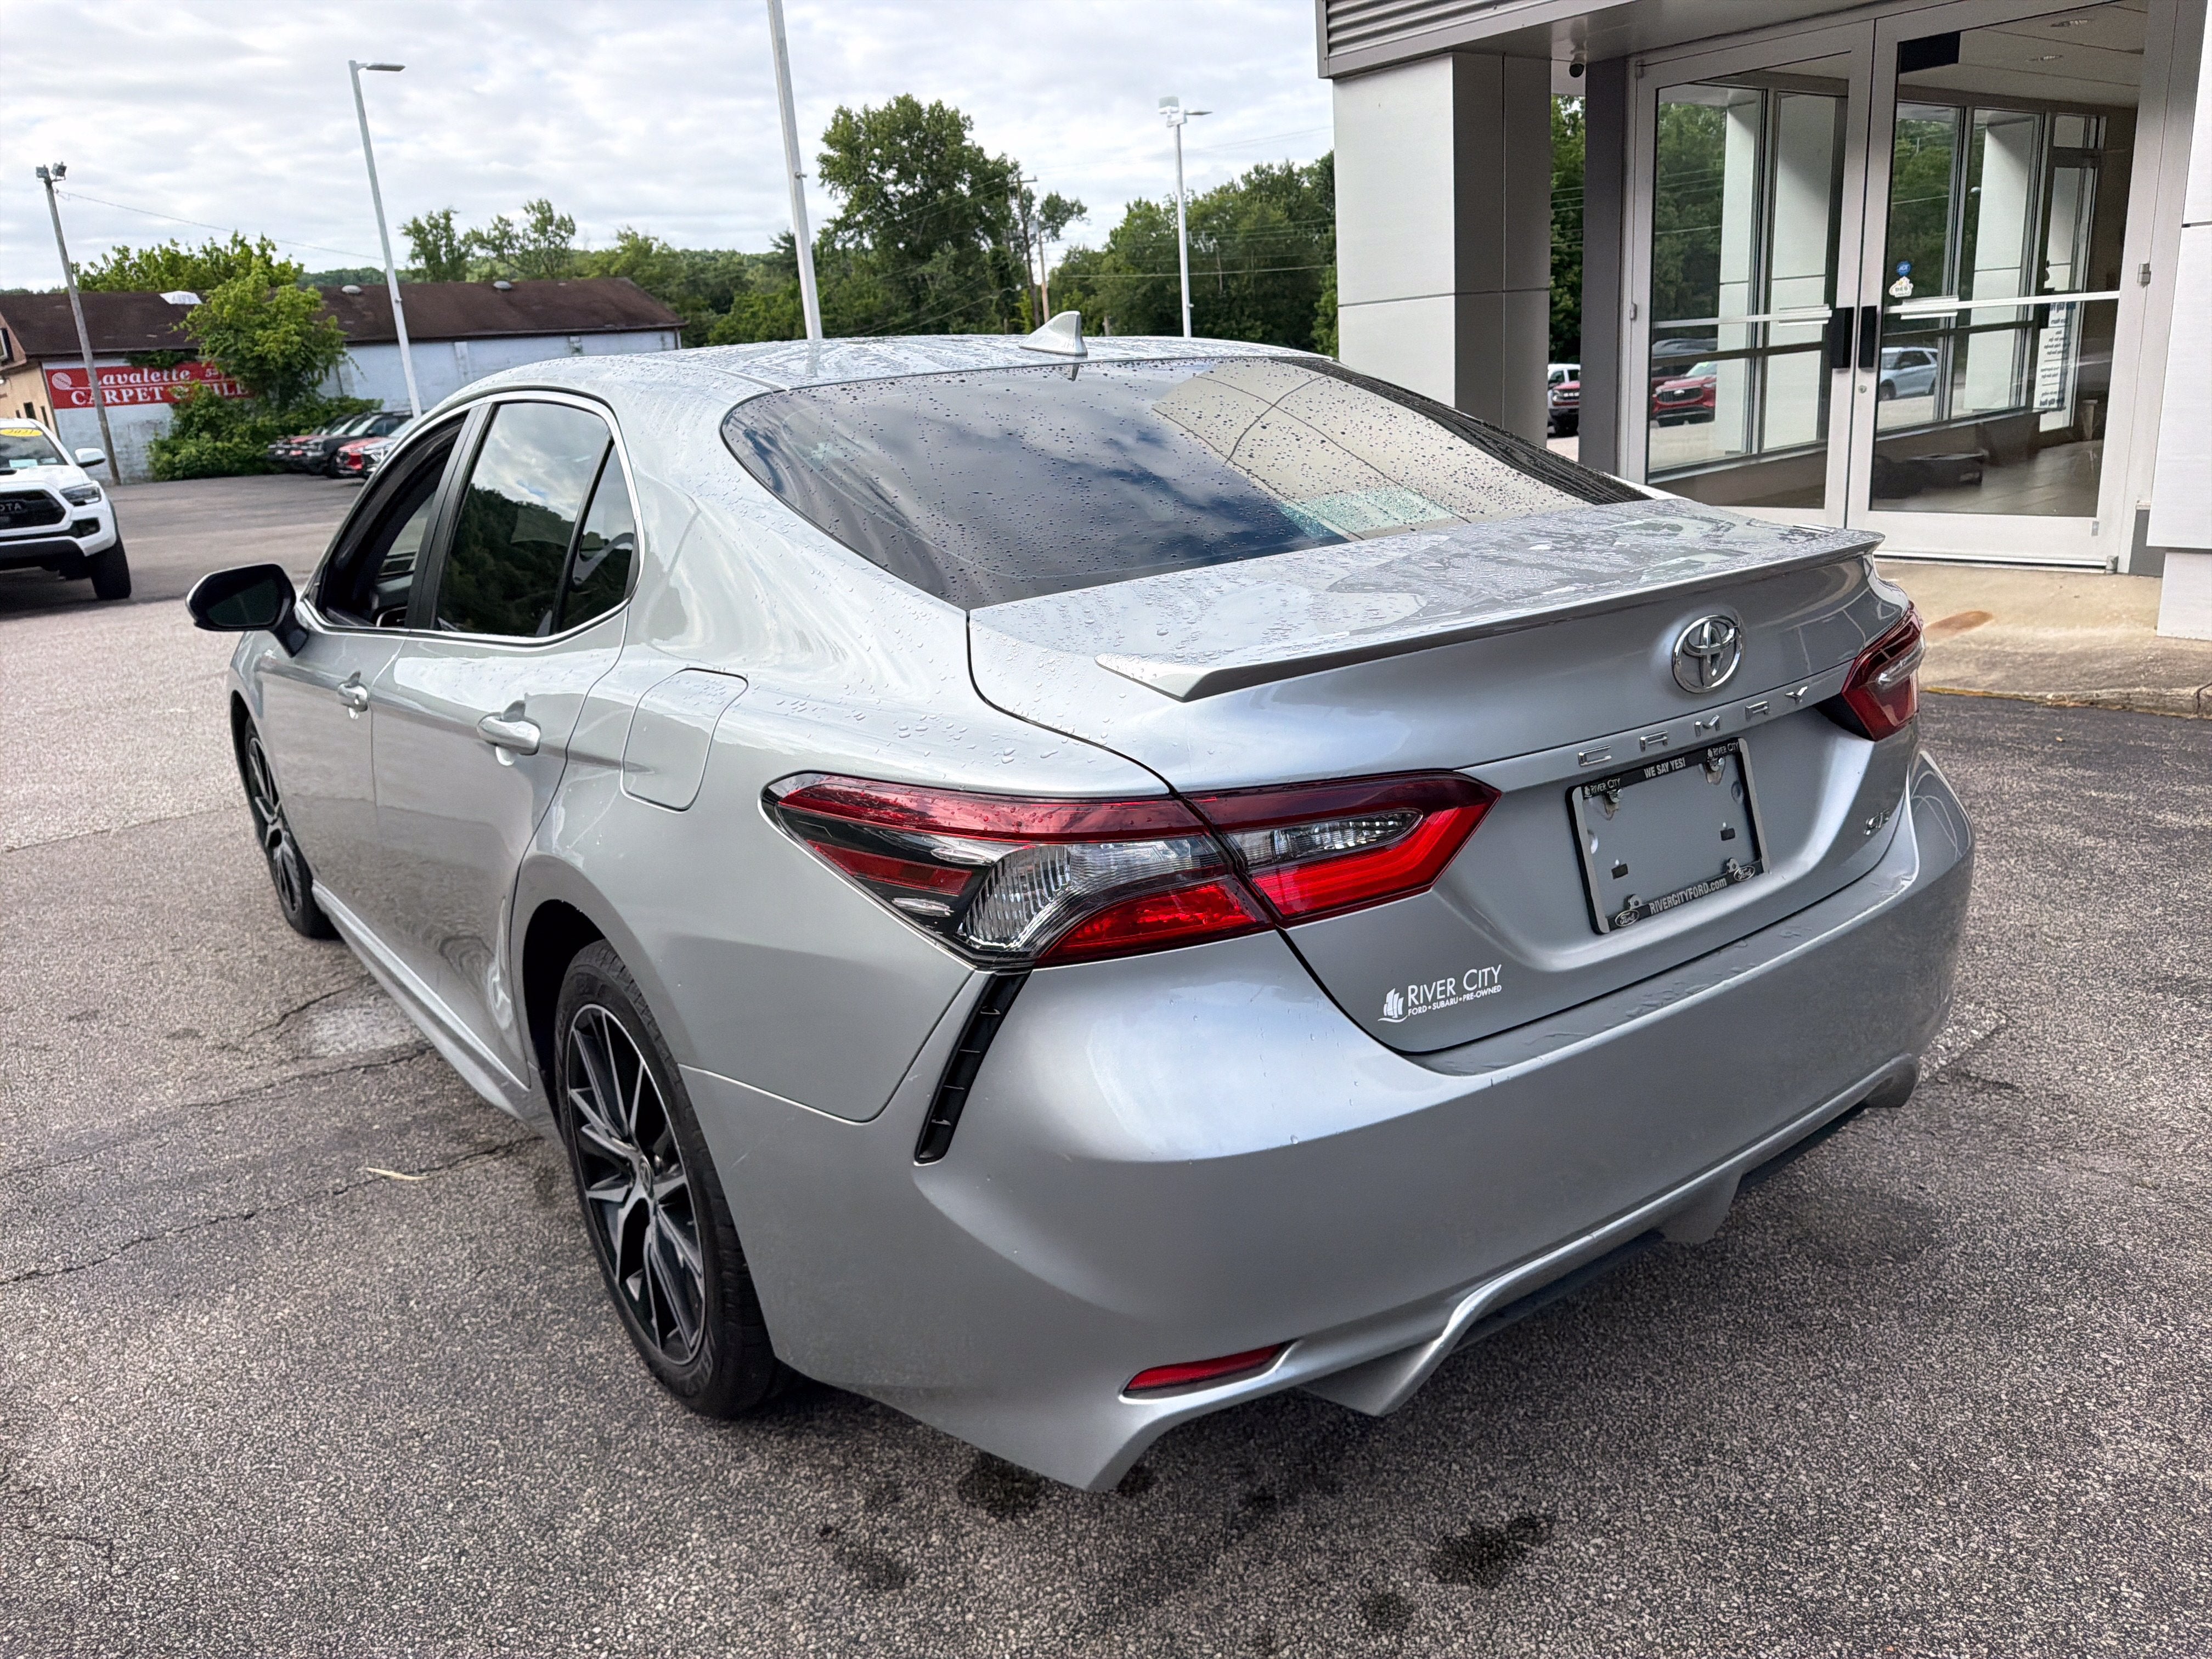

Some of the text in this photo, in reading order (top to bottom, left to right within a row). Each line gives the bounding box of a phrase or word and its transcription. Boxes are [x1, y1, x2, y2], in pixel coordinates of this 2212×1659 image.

[1577, 686, 1808, 767] CAMRY
[1713, 741, 1739, 756] RIVER CITY
[1644, 757, 1686, 778] WE SAY YES!
[1590, 777, 1621, 794] RIVER CITY
[1737, 866, 1752, 879] Ford
[1649, 877, 1728, 915] RIVERCITYFORD.com
[1619, 912, 1635, 925] Ford
[1408, 964, 1502, 1007] RIVER CITY
[1408, 984, 1502, 1017] FORD SUBARU PRE-OWNED
